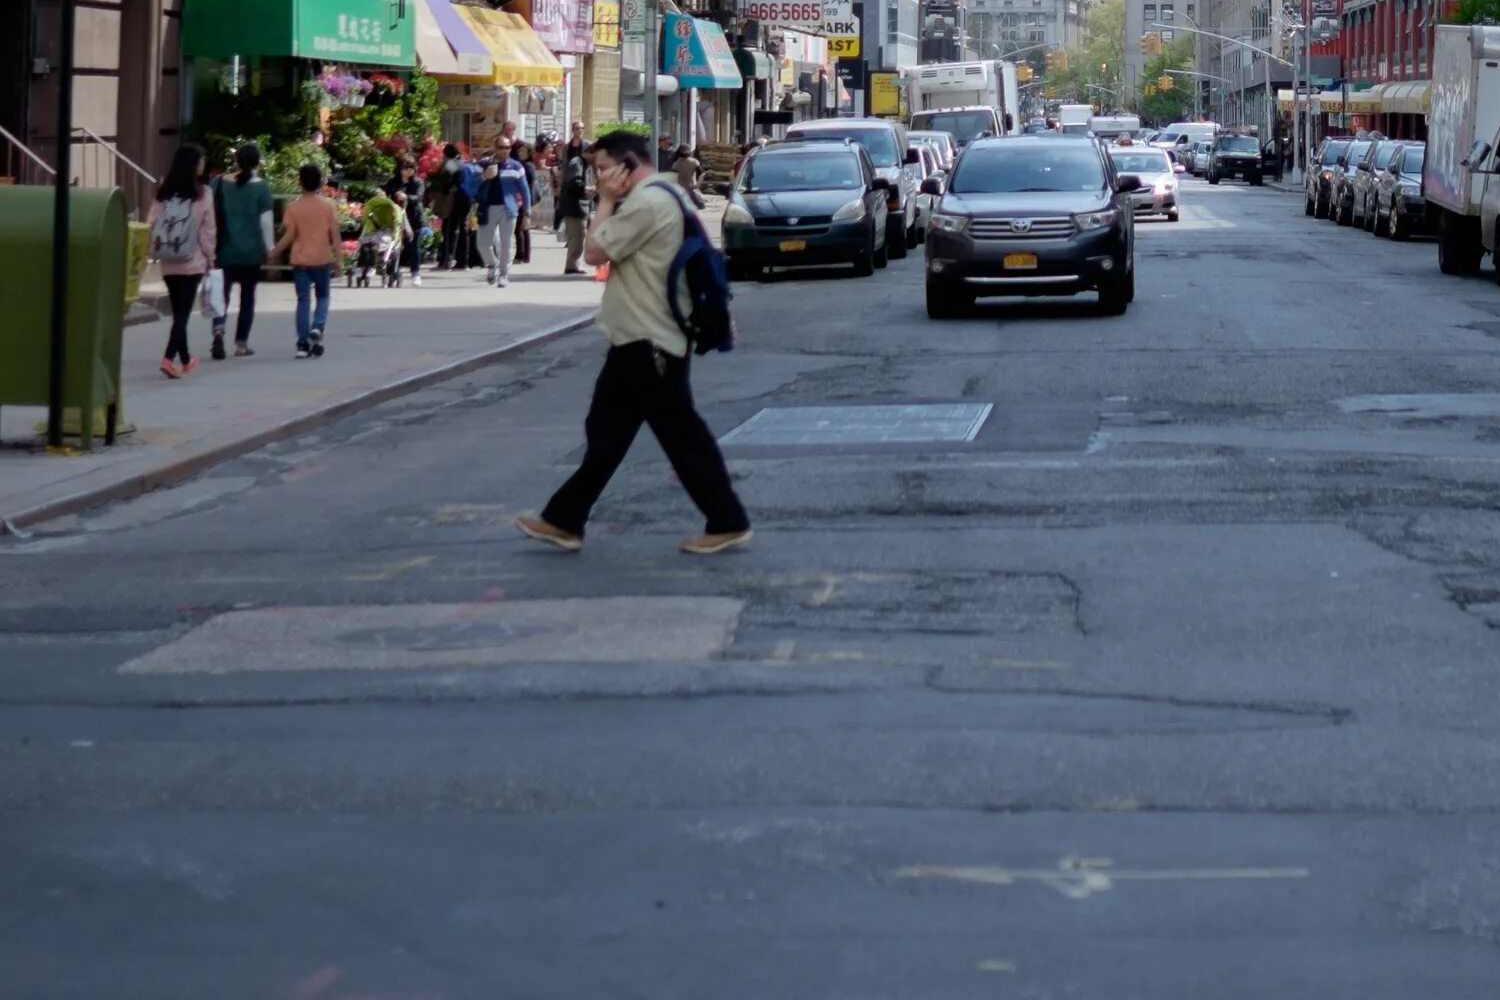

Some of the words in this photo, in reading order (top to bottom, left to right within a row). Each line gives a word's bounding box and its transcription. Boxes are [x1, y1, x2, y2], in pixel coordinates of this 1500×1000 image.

[748, 3, 821, 21] 966-5665
[826, 22, 855, 34] ARK
[827, 39, 855, 51] AST
